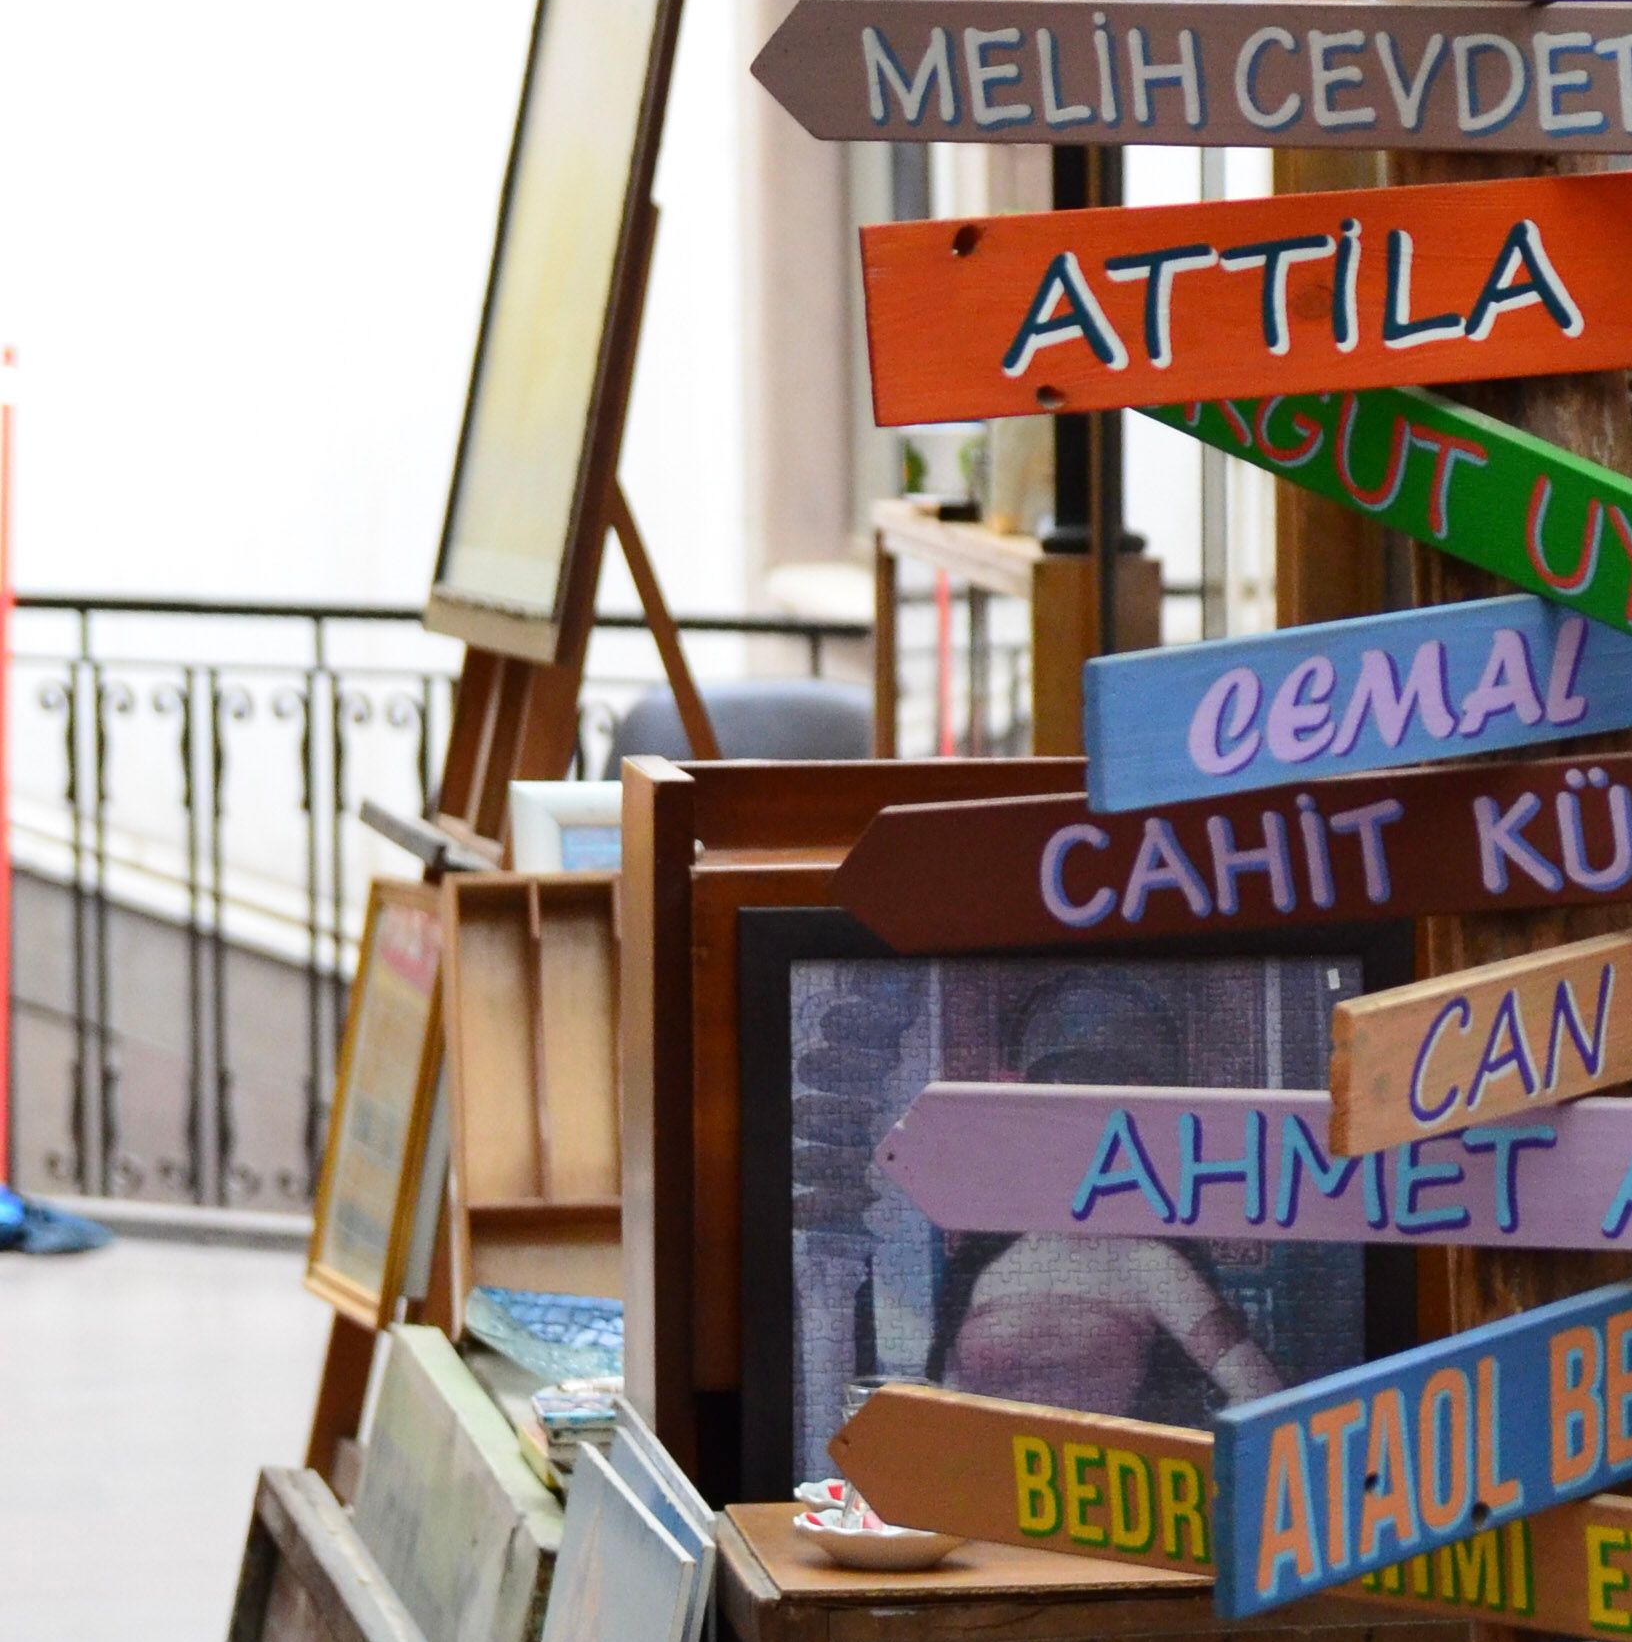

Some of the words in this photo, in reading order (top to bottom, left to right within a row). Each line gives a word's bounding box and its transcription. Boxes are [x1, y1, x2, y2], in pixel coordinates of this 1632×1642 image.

[860, 11, 1203, 127] MELİH
[1002, 215, 1587, 379] ATTİLA
[1189, 615, 1589, 780] CEMAL
[1039, 793, 1402, 932] CAHİT
[1406, 962, 1616, 1130] CAN
[1068, 1107, 1558, 1239] AHMET
[1255, 1356, 1526, 1600] ATAOL
